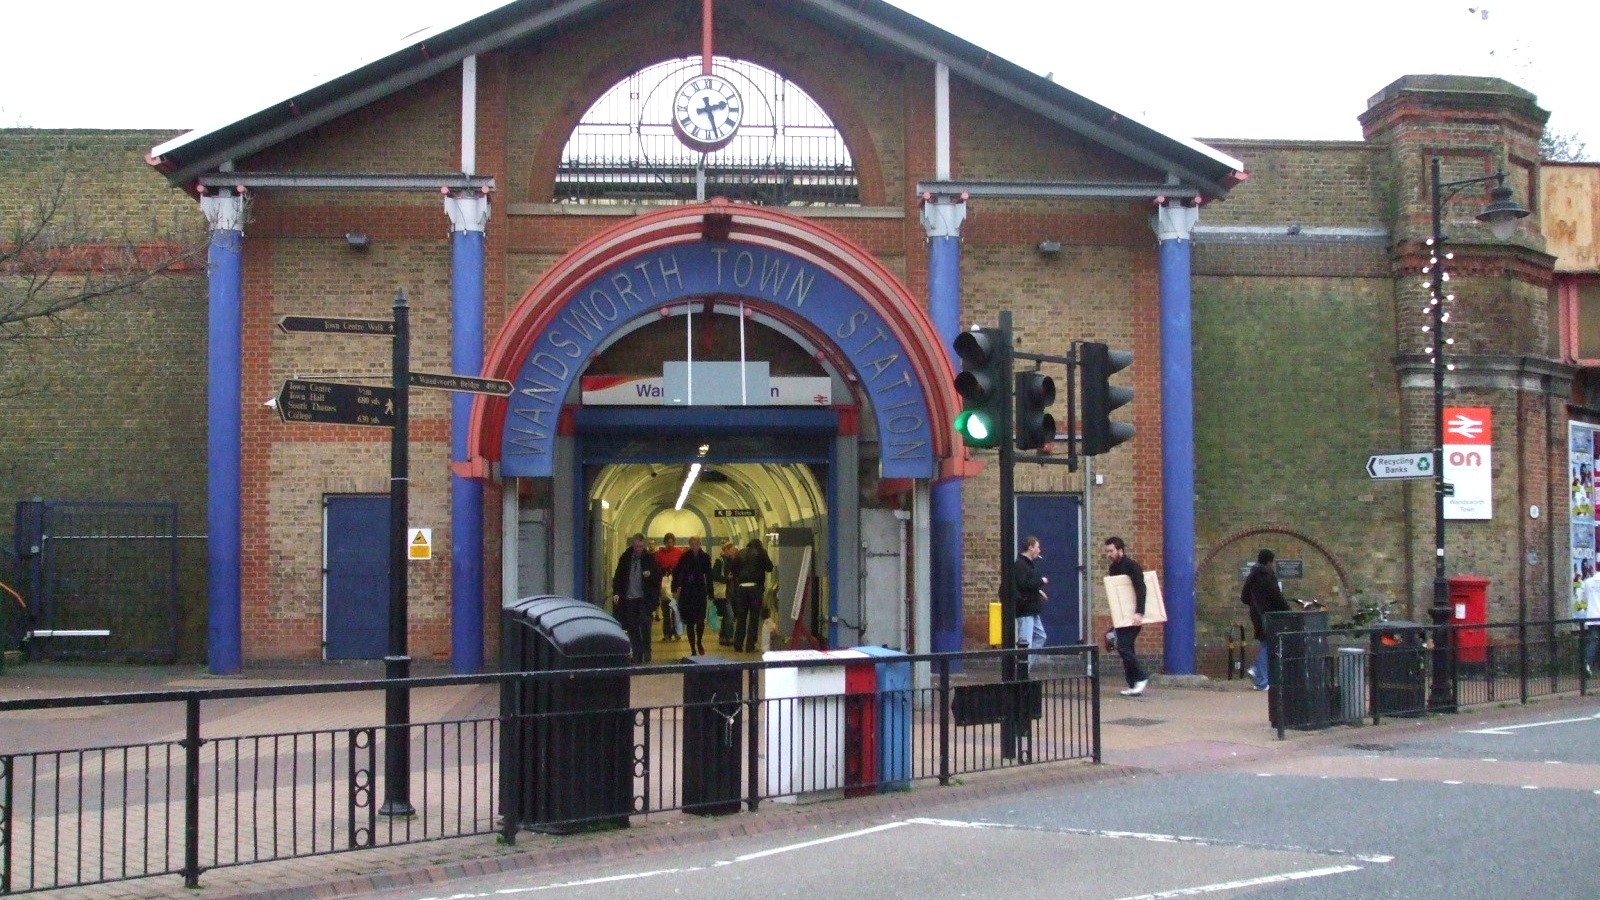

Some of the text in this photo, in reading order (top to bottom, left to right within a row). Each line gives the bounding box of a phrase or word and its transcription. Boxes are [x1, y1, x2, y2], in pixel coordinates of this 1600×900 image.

[509, 247, 926, 461] WANDSWORTH TOWN STATION
[289, 382, 306, 391] Town
[310, 384, 332, 393] Centre
[289, 392, 306, 400] Town
[310, 394, 324, 402] Hall
[288, 402, 336, 412] South Thames
[288, 410, 312, 422] College
[1379, 458, 1414, 466] Recycling
